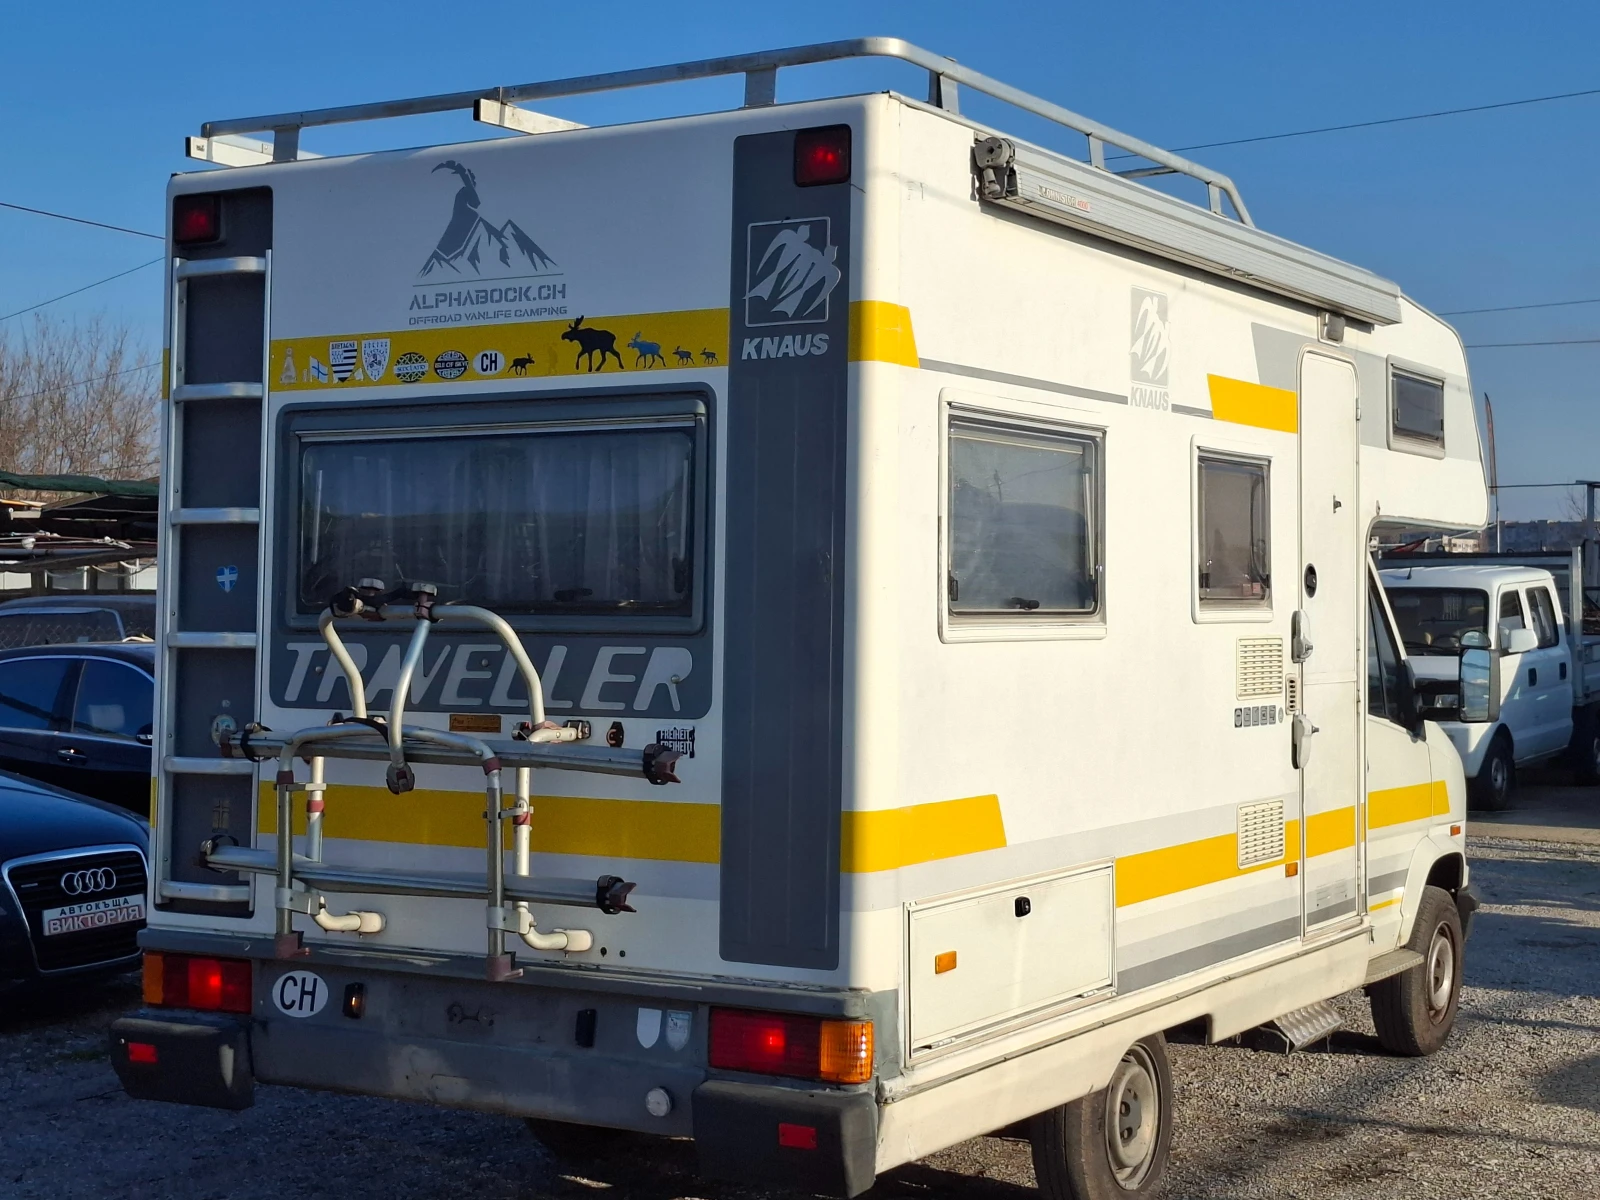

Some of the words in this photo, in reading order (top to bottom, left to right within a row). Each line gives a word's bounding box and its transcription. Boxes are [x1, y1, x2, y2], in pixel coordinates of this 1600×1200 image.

[409, 283, 567, 311] ALPHABOCK.CH
[408, 313, 462, 326] OFFROAD
[464, 309, 512, 322] VANLIFE
[514, 305, 568, 318] CAMPING
[741, 333, 830, 360] KNAUS
[480, 352, 498, 372] CH
[1130, 386, 1170, 412] KNAUS
[284, 642, 693, 712] TRAVELLER
[49, 905, 140, 934] ВИКТОРИЯ
[60, 897, 130, 916] АВТОКЪША
[279, 975, 318, 1012] CH
